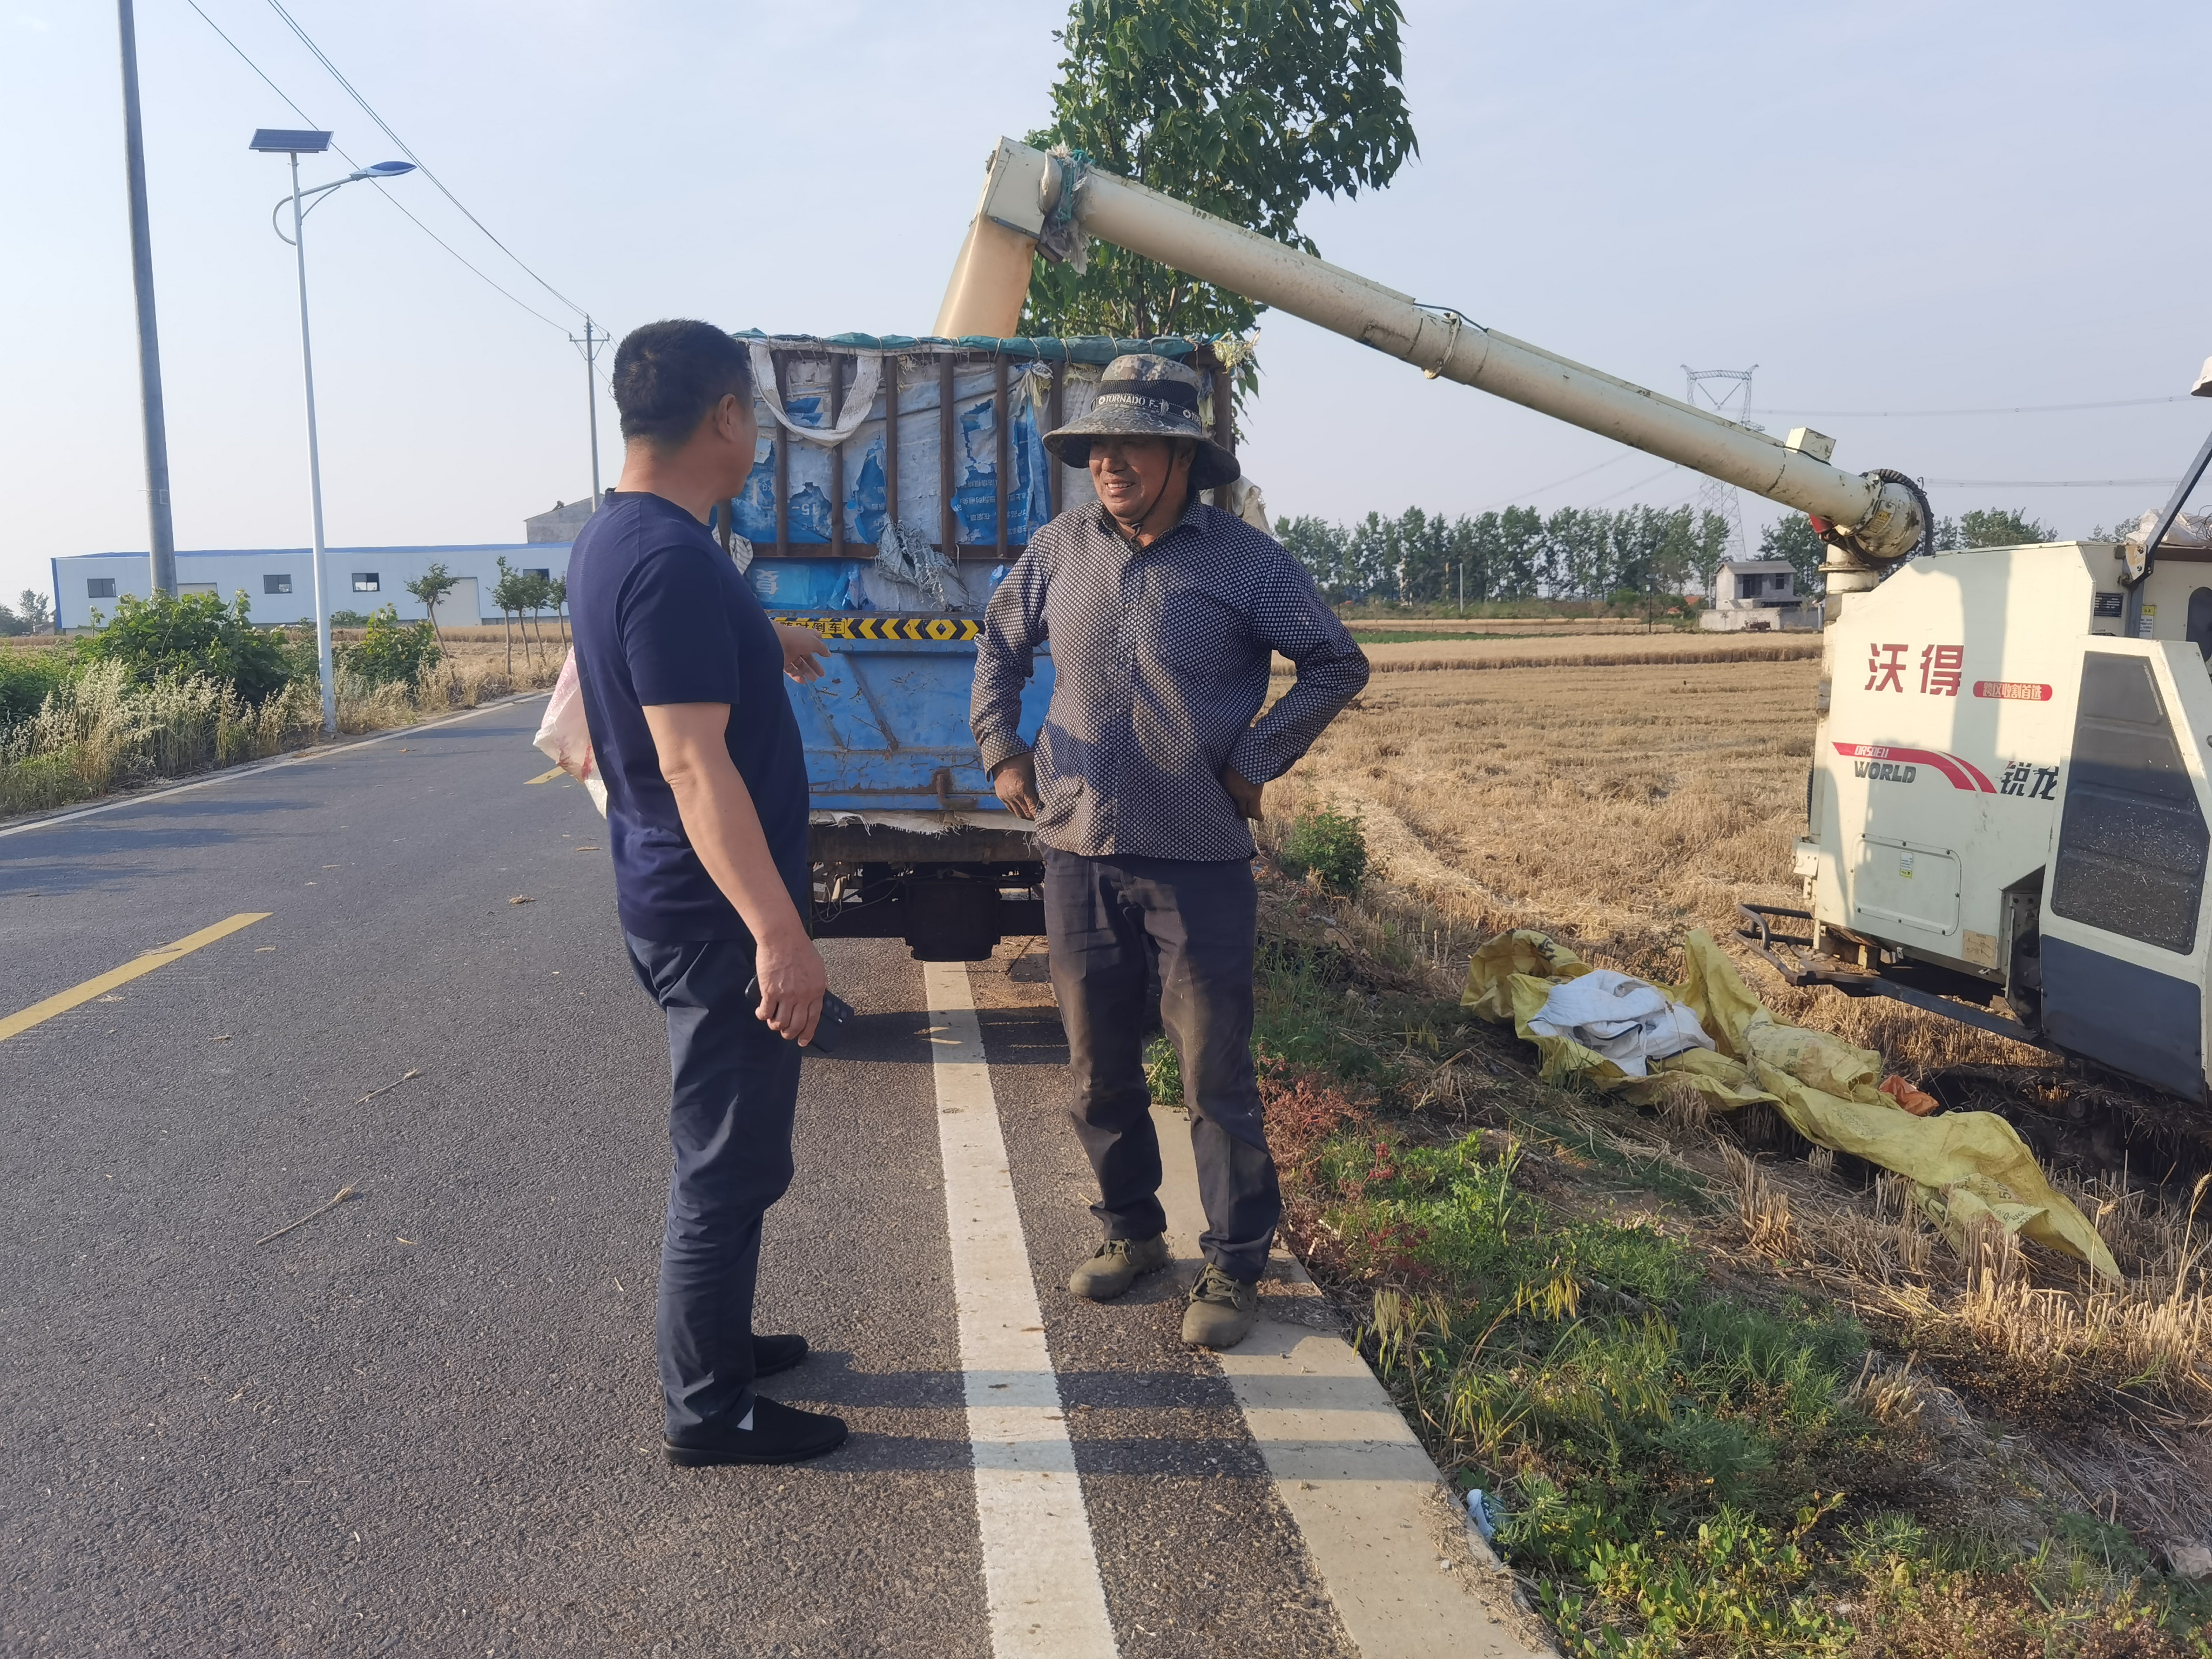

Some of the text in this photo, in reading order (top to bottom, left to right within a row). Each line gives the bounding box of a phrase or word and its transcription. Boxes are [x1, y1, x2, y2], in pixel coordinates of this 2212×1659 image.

[1106, 395, 1145, 405] TORNADO
[1864, 643, 1965, 697] 沃得
[1982, 682, 2042, 700] 跨区收割首选
[1854, 760, 1917, 784] WORLD
[2000, 760, 2059, 800] 锐龙
